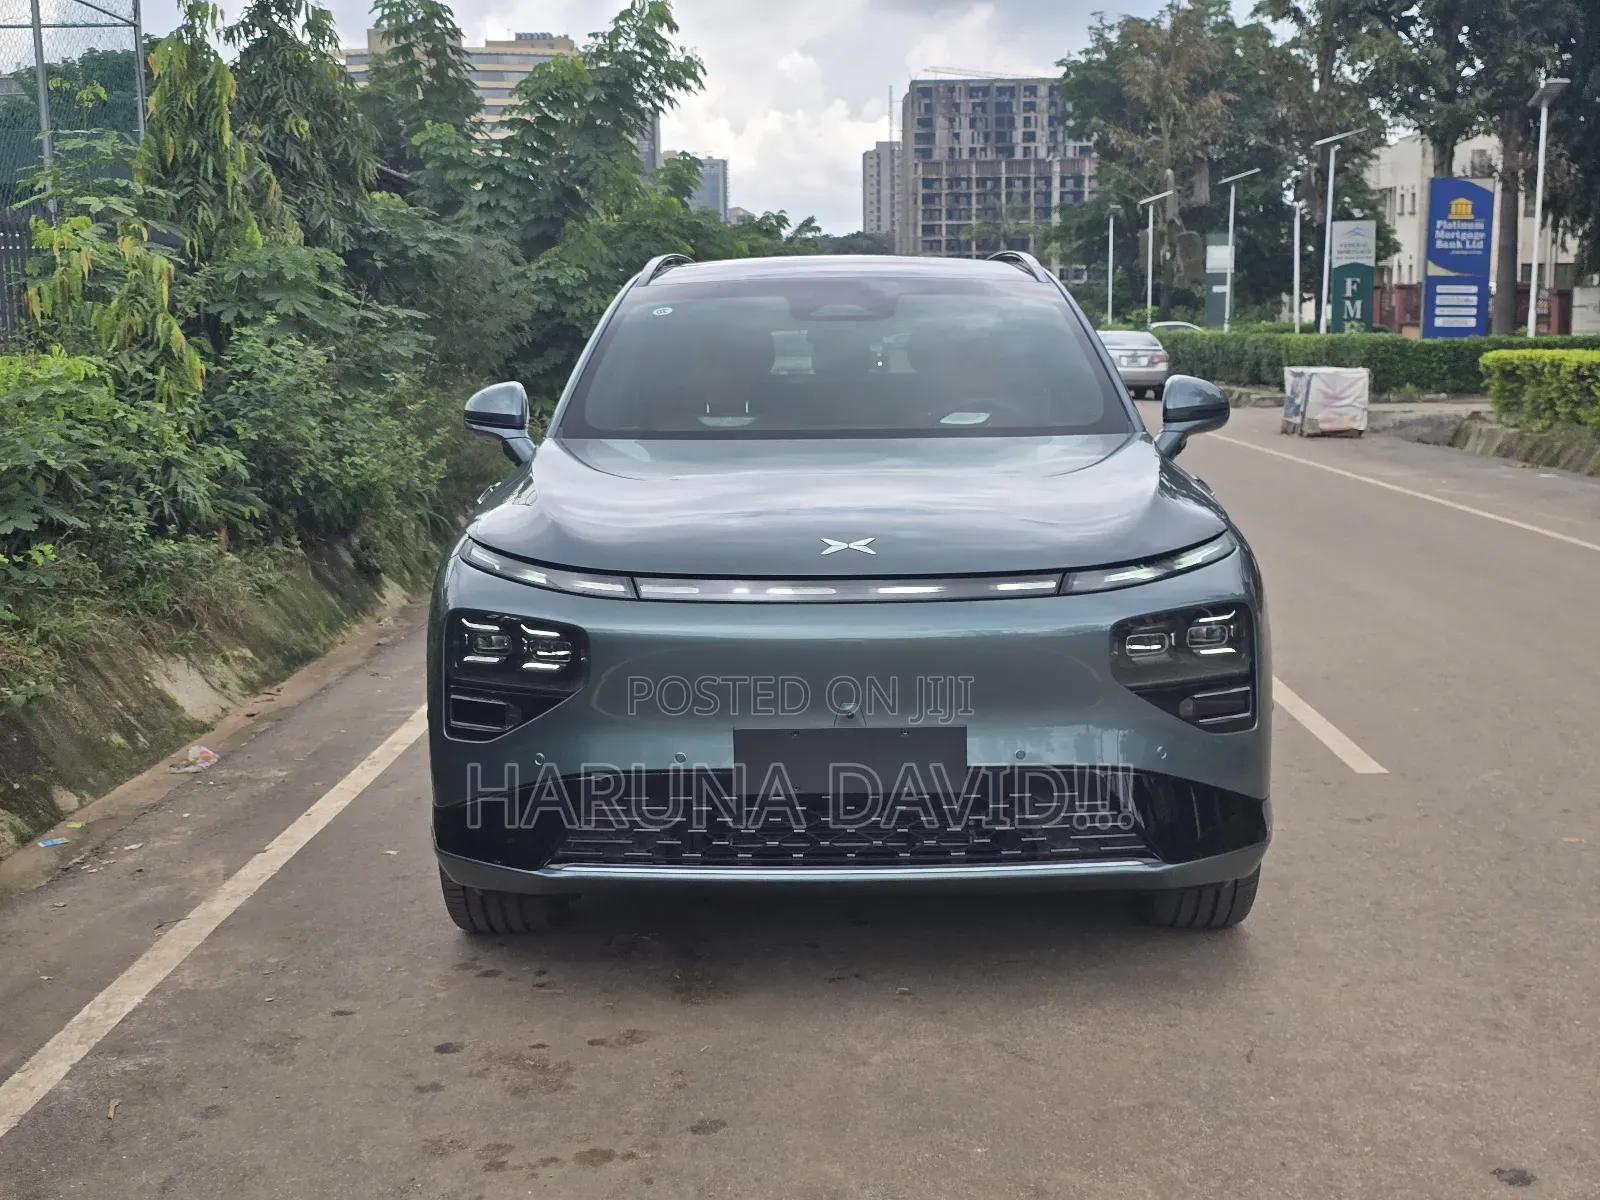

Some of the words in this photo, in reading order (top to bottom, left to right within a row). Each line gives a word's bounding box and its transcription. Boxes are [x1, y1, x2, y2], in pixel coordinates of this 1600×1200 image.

[1436, 219, 1485, 230] Platinum
[1435, 230, 1486, 241] Mortgage
[1435, 240, 1463, 249] Bank
[1465, 240, 1484, 249] Ltd
